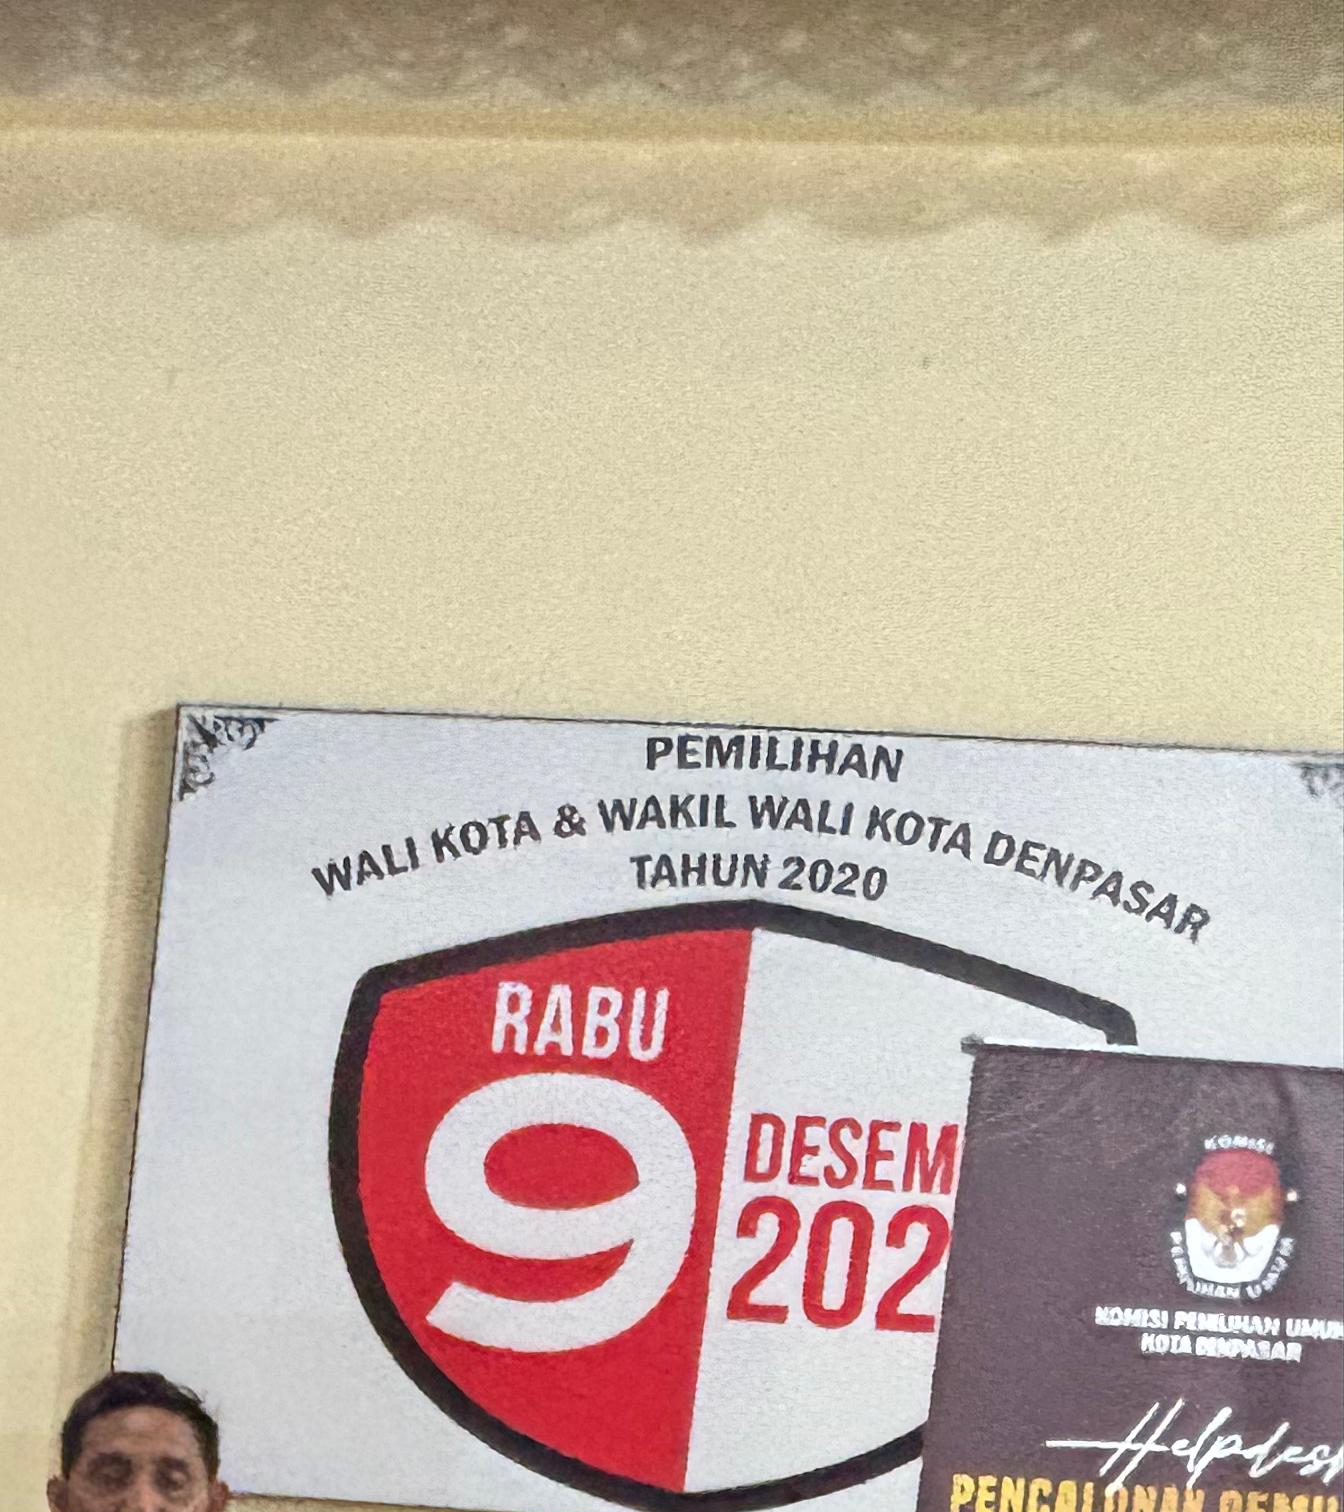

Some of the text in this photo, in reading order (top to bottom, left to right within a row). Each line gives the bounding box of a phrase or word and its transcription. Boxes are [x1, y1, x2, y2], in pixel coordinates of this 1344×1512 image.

[645, 734, 904, 783] PEMILIHAN
[311, 793, 1212, 945] WALI KOTA & WAKIL WALI KOTA DENPASAR
[629, 852, 888, 902] TAHUN 2020
[489, 981, 672, 1062] RABU
[1203, 1134, 1276, 1155] KOMISI
[423, 1071, 699, 1352] 9
[1095, 1305, 1169, 1329] KOMISI
[1173, 1310, 1281, 1336] PEMILIHAN
[1140, 1332, 1303, 1363] KOTA DENPASAR
